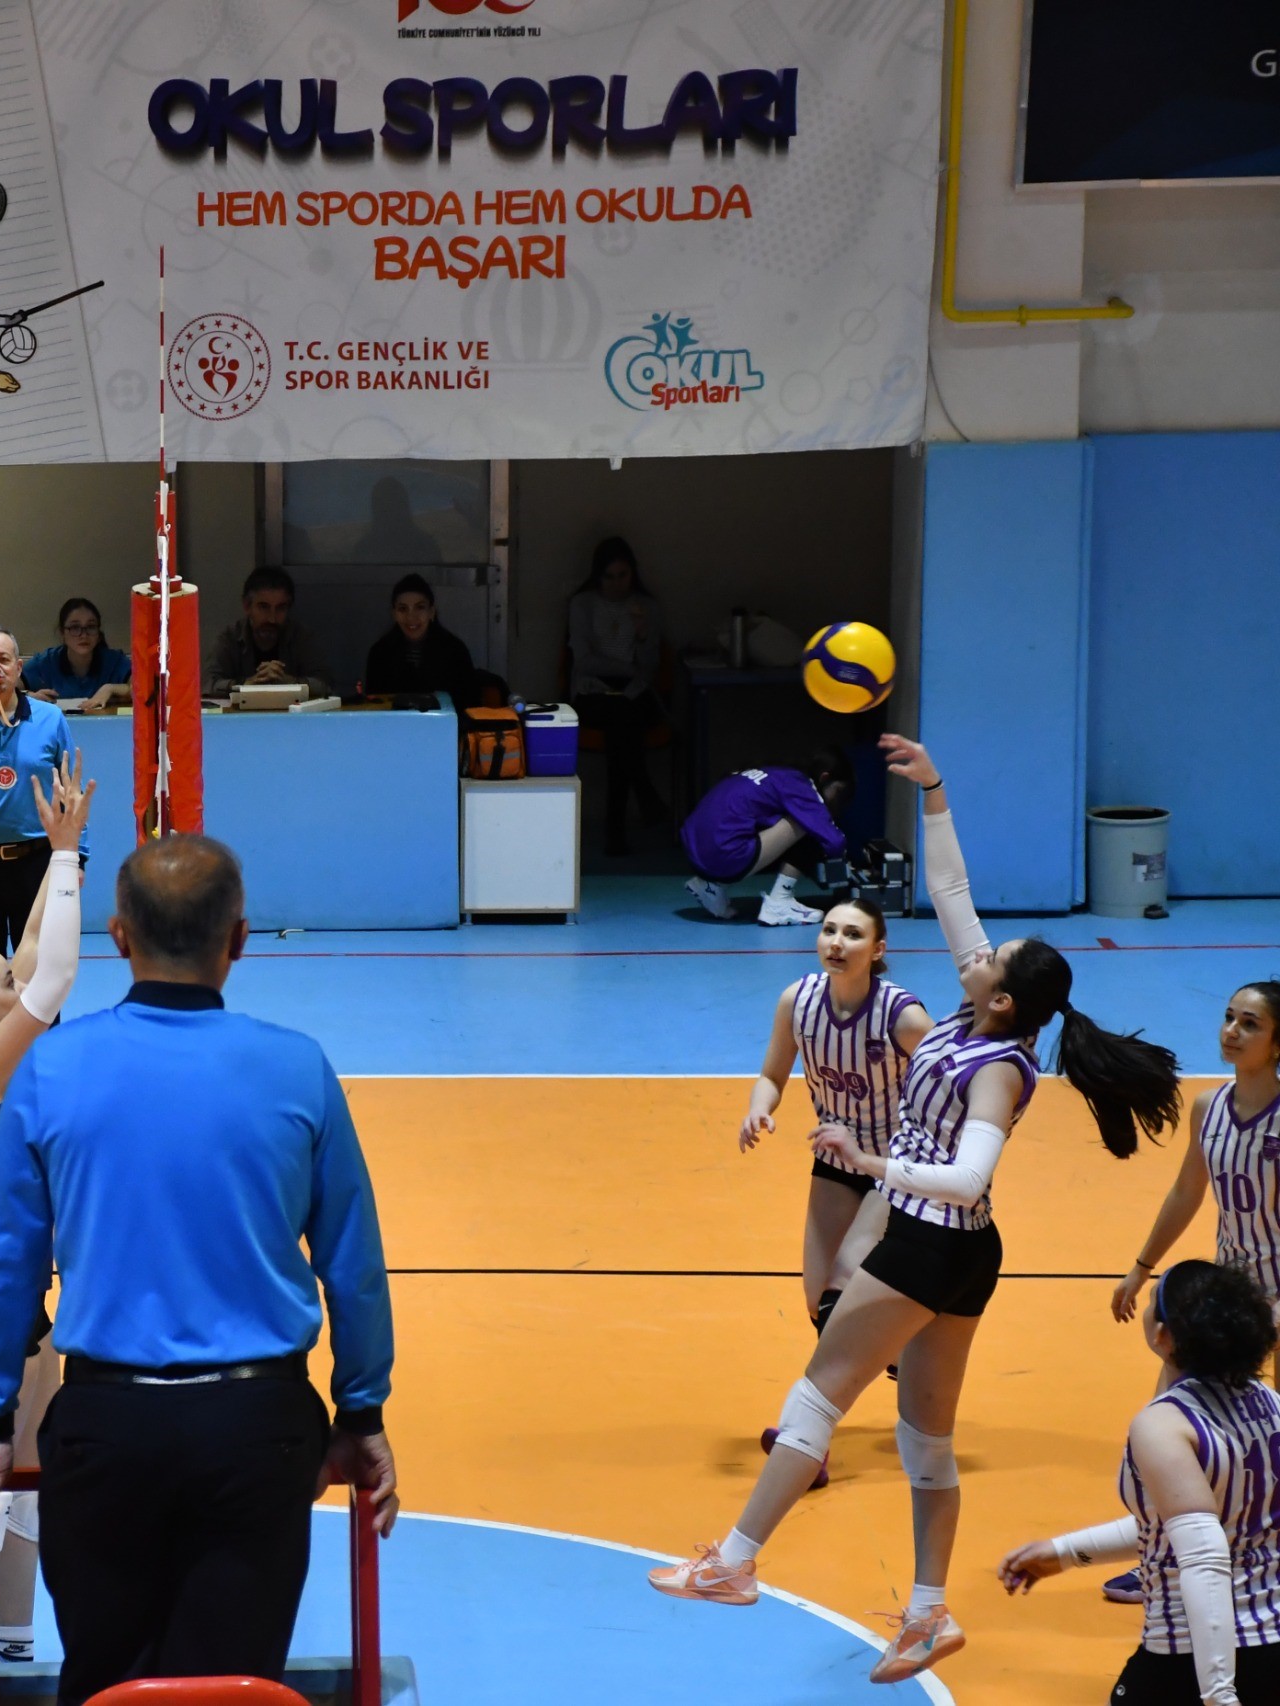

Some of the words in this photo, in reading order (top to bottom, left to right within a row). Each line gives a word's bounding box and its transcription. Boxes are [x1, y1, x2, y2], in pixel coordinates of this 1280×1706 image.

[398, 27, 426, 39] TÜRKİYE
[493, 26, 525, 38] YÜZÜNCÜ
[527, 26, 541, 37] YILI
[148, 78, 375, 152] OKUL
[379, 68, 798, 152] SPORLARI
[198, 191, 287, 227] HEM
[296, 190, 466, 227] SPORDA
[474, 189, 567, 226] HEM
[576, 184, 753, 223] OKULDA
[374, 235, 566, 289] BAŞARI
[284, 341, 330, 361] T.C.
[337, 337, 448, 366] GENÇLİK
[458, 341, 490, 361] VE
[285, 370, 350, 390] SPOR
[357, 366, 490, 390] BAKANLIĞI
[626, 349, 765, 396] OKUL
[650, 379, 741, 411] Sporları
[819, 1065, 869, 1101] 99
[1215, 1171, 1257, 1214] 10
